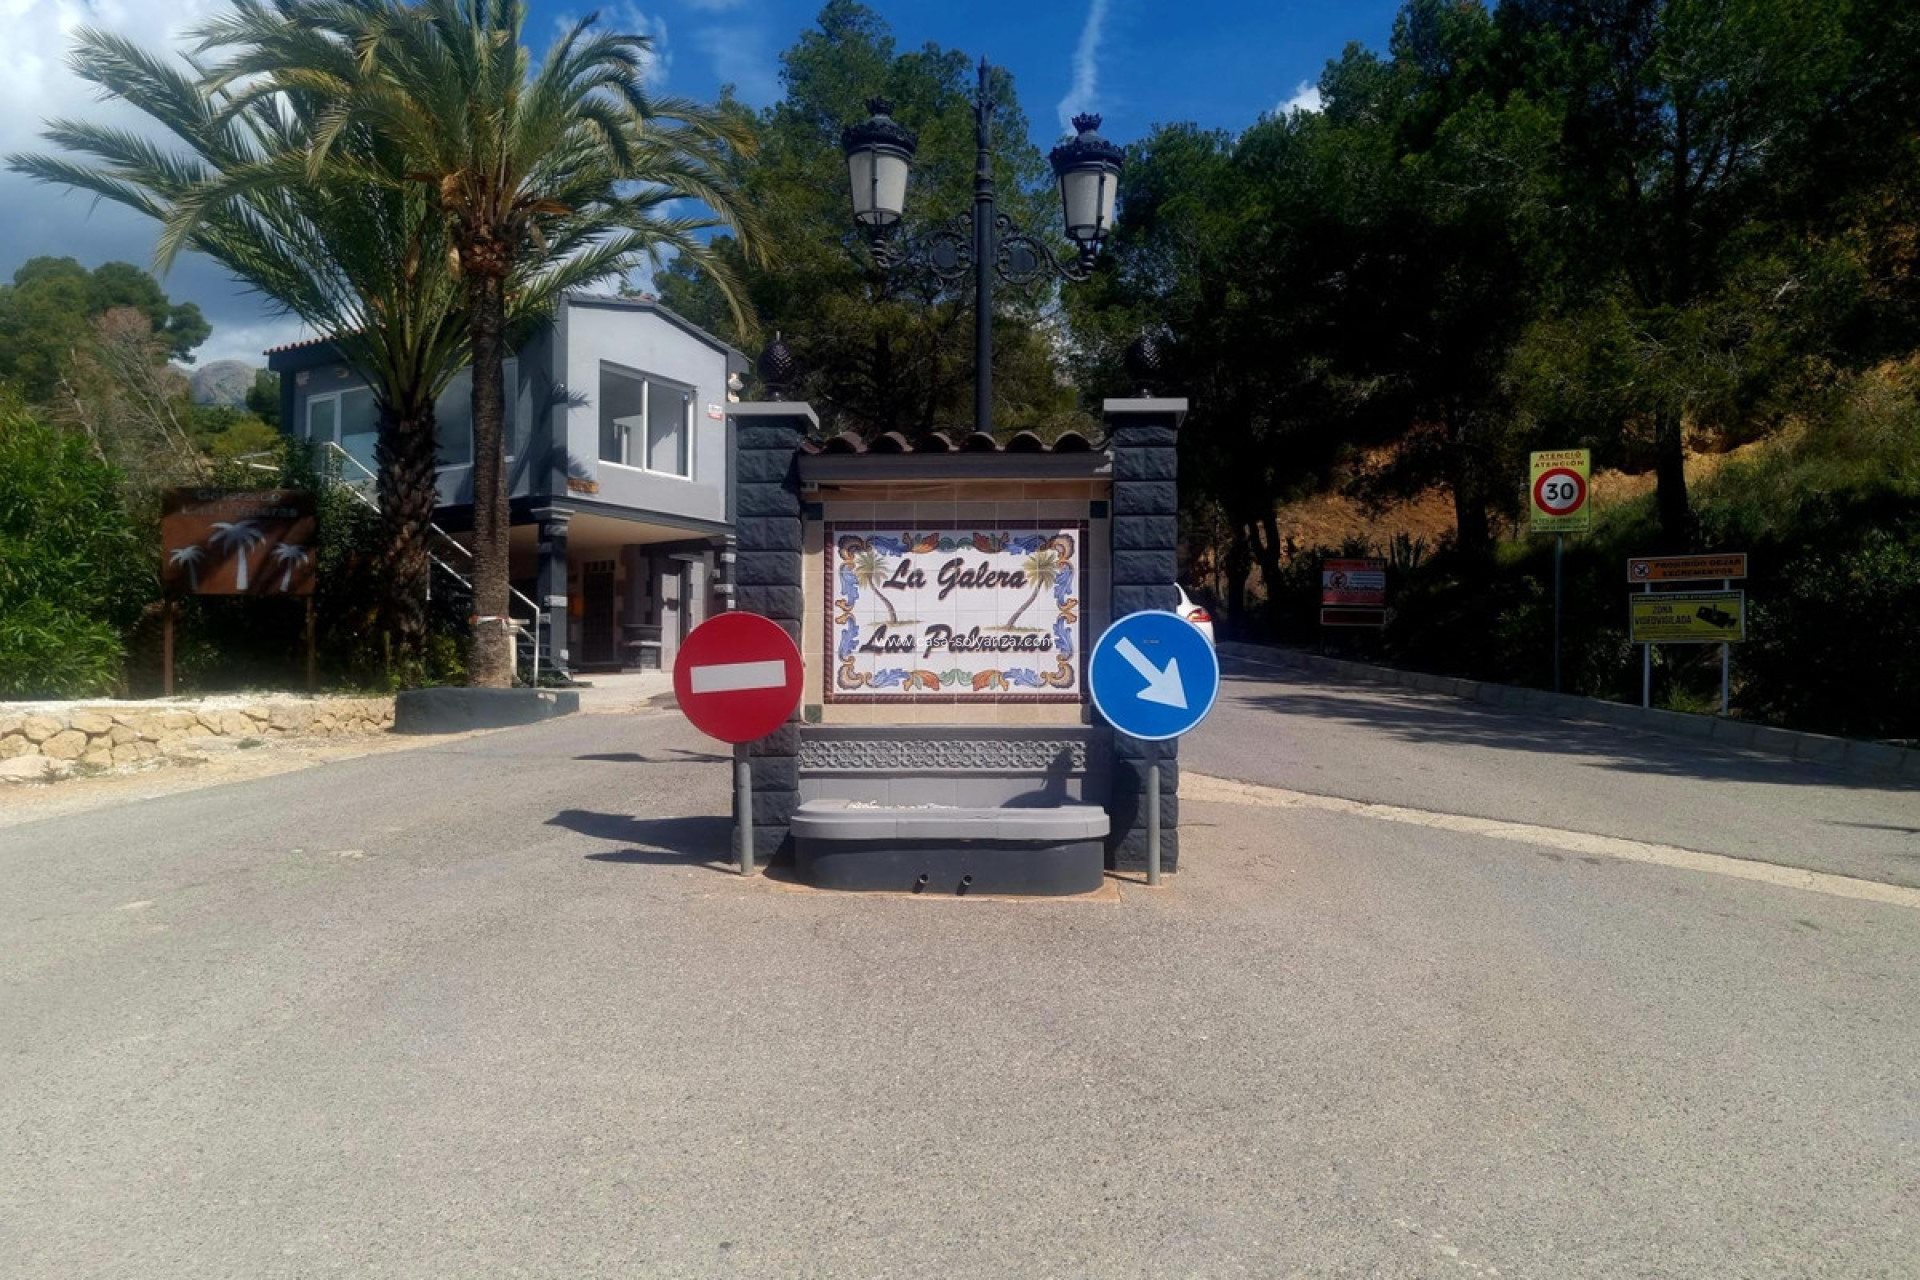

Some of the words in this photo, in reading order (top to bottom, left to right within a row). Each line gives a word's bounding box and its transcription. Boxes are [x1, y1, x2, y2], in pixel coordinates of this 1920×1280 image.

[1546, 482, 1574, 500] 30
[883, 558, 926, 590] La
[937, 557, 1028, 601] Galera
[1652, 605, 1673, 614] ZONA
[858, 624, 915, 654] Las
[922, 623, 1053, 659] Palmeras
